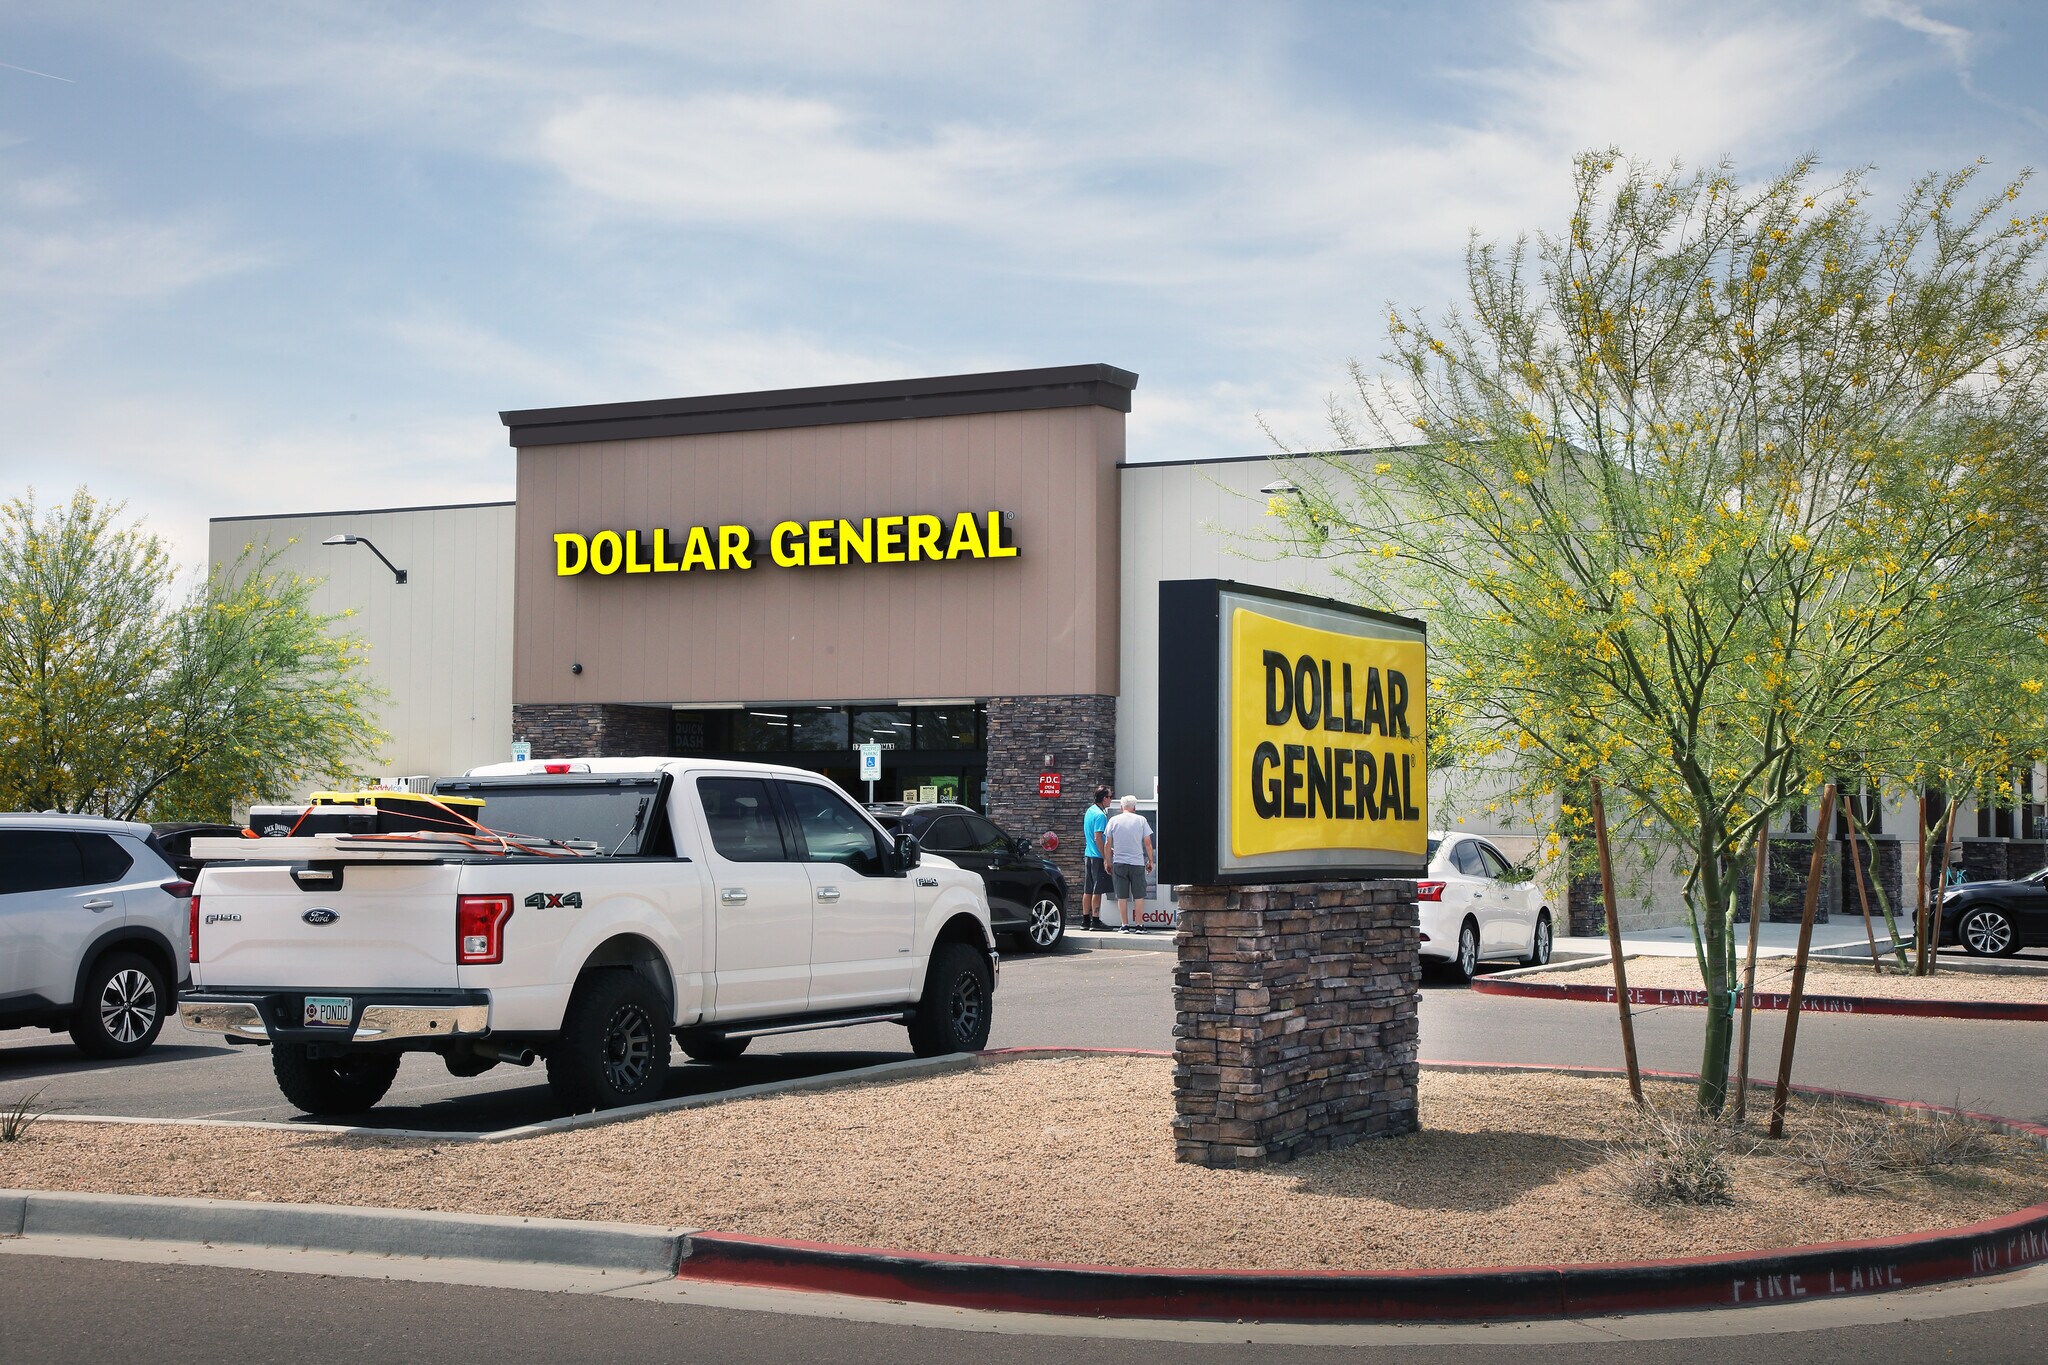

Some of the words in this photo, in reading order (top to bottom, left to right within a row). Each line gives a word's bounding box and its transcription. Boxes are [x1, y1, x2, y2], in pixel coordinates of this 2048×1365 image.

[554, 524, 755, 576] DOLLAR
[770, 511, 1020, 568] GENERAL
[1263, 650, 1410, 740] DOLLAR
[1252, 741, 1420, 821] GENERAL
[320, 1004, 348, 1021] PONDO
[1606, 988, 1645, 1003] FRE
[1659, 991, 1704, 1005] LANE
[1773, 996, 1853, 1013] PRKING
[1829, 1264, 1902, 1294] LANE
[1972, 1244, 1997, 1273] NO
